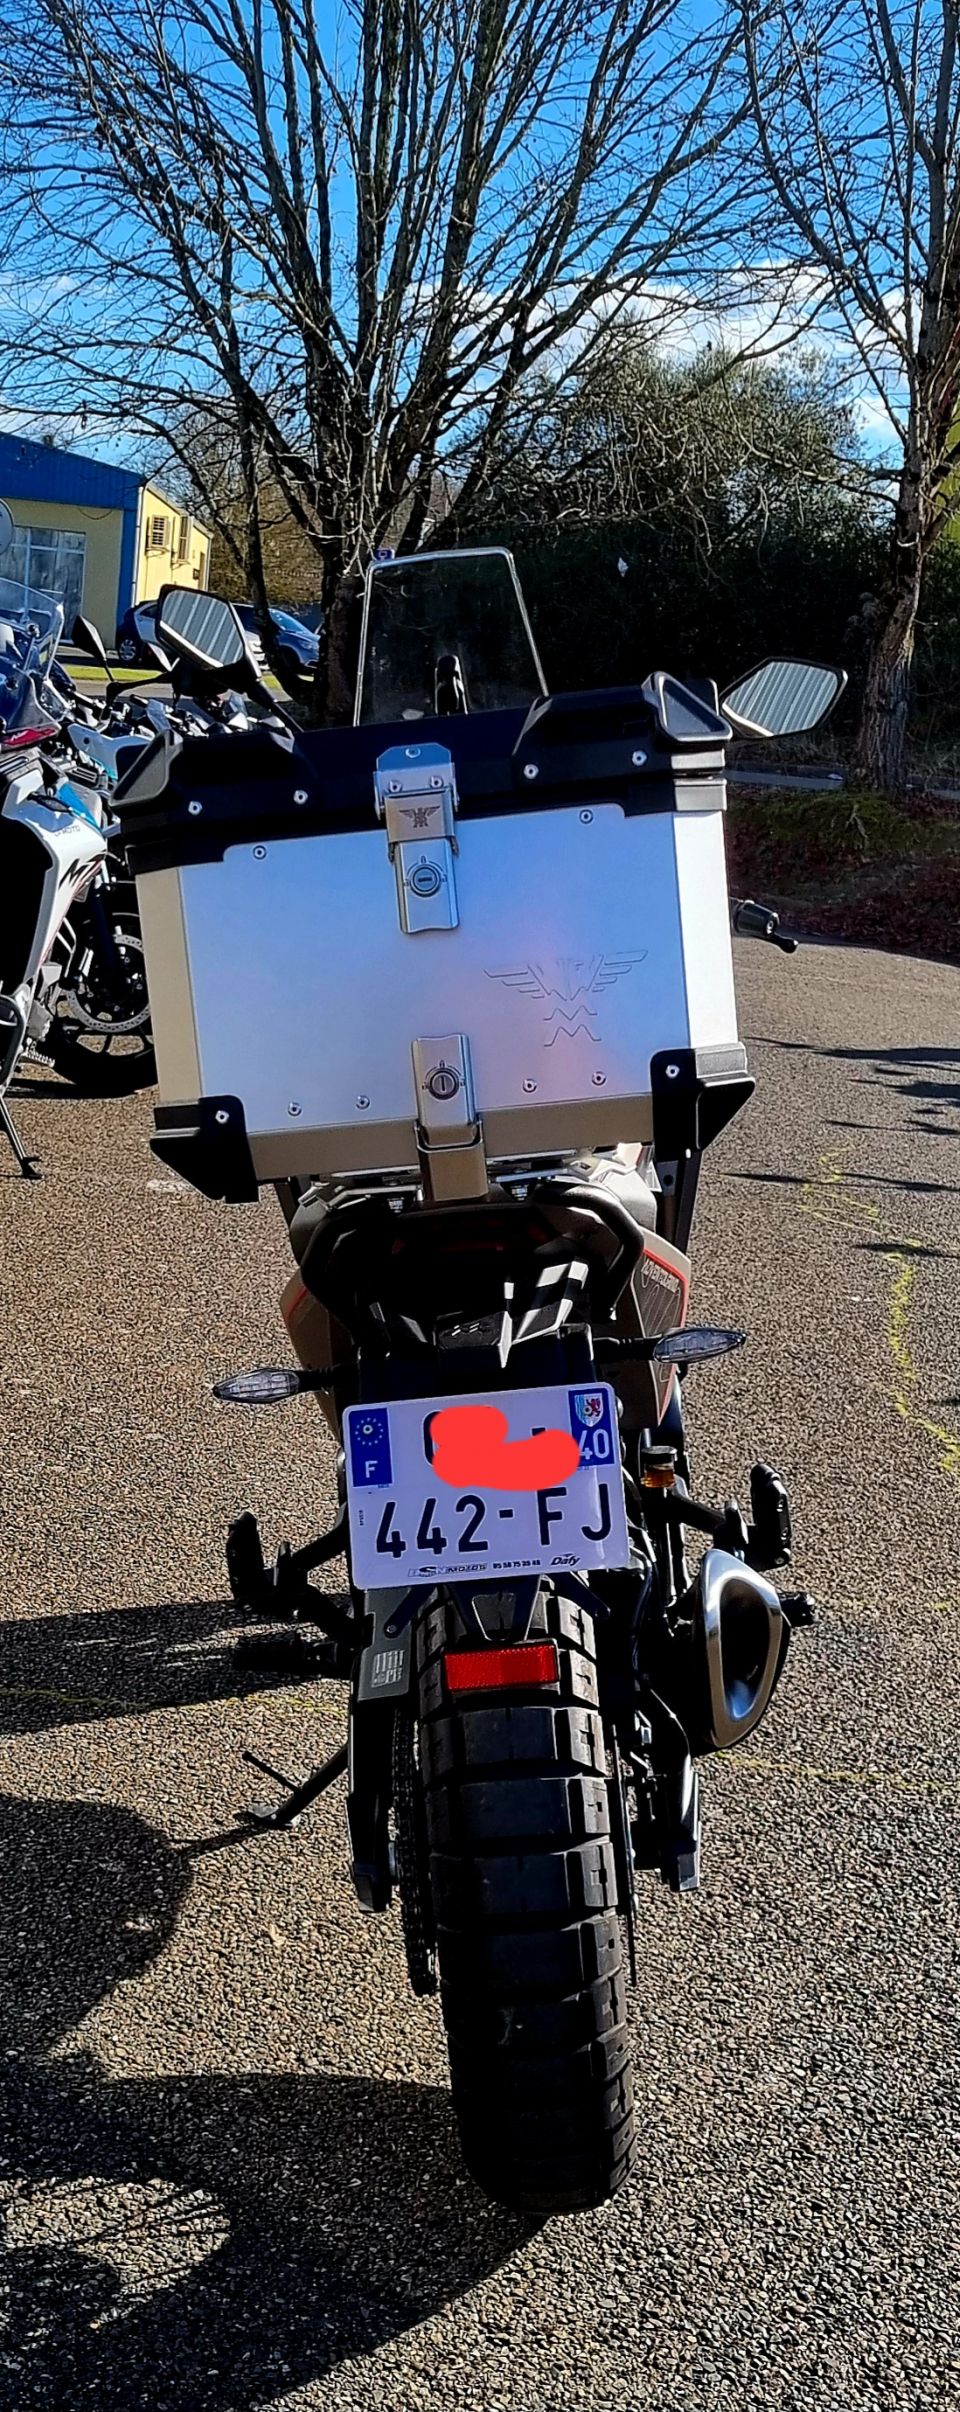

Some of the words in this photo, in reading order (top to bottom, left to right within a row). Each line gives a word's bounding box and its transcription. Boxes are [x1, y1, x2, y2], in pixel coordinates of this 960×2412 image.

[579, 1428, 610, 1460] 40
[364, 1460, 378, 1478] F
[551, 1553, 581, 1566] Dafy
